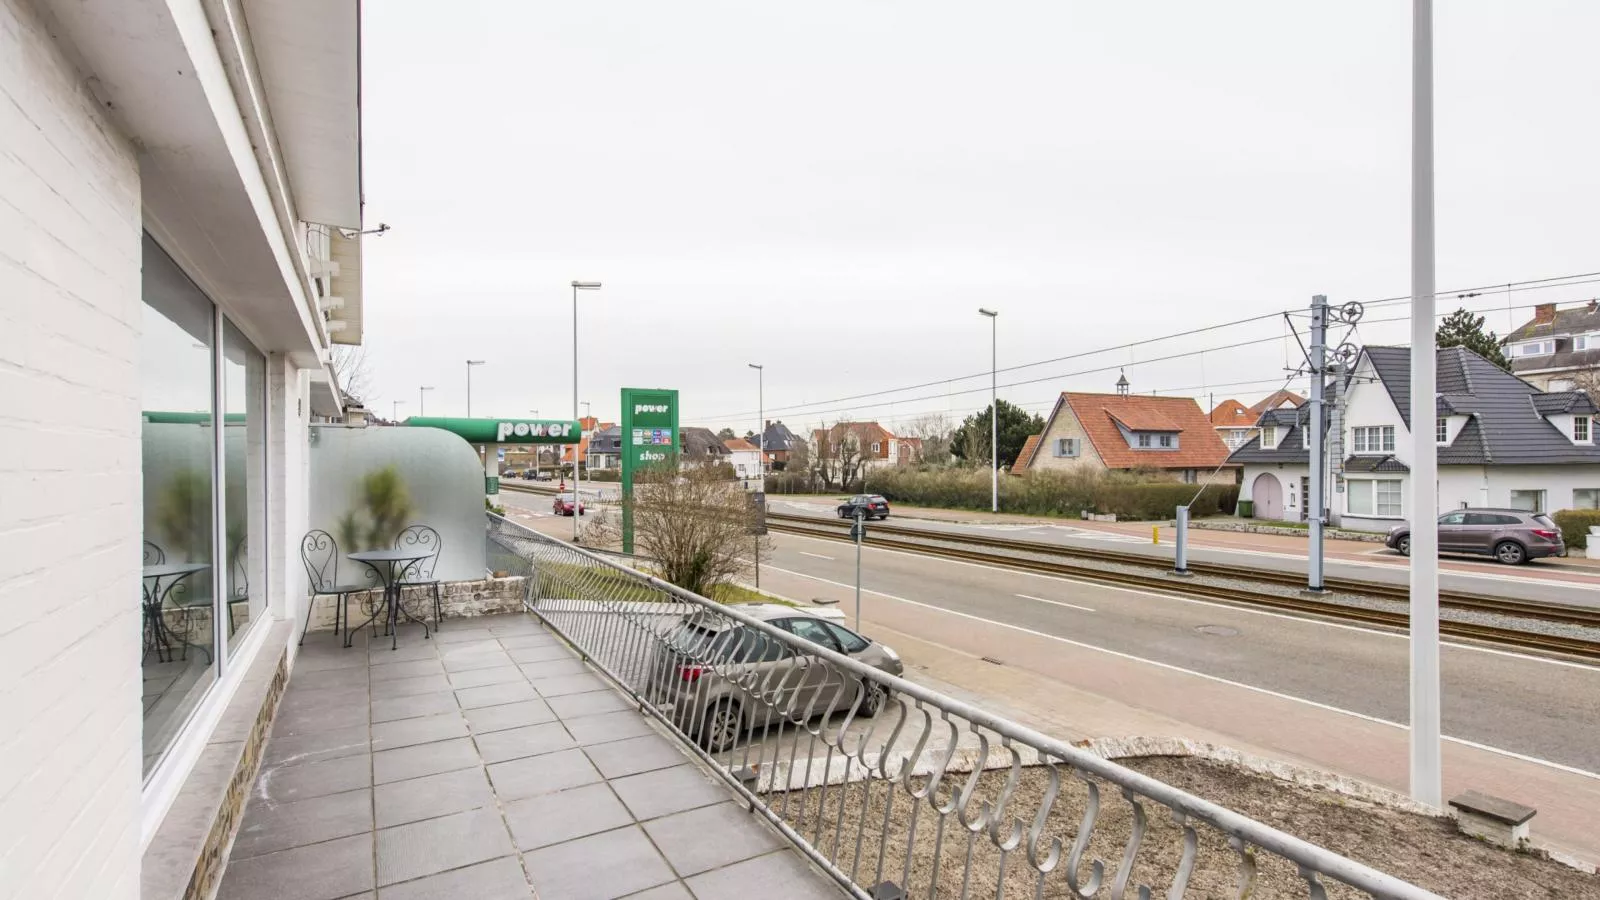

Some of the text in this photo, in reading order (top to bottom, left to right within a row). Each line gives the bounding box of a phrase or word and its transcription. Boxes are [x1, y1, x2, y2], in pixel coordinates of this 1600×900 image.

[634, 404, 668, 415] power
[497, 422, 572, 442] power
[639, 450, 665, 461] shop
